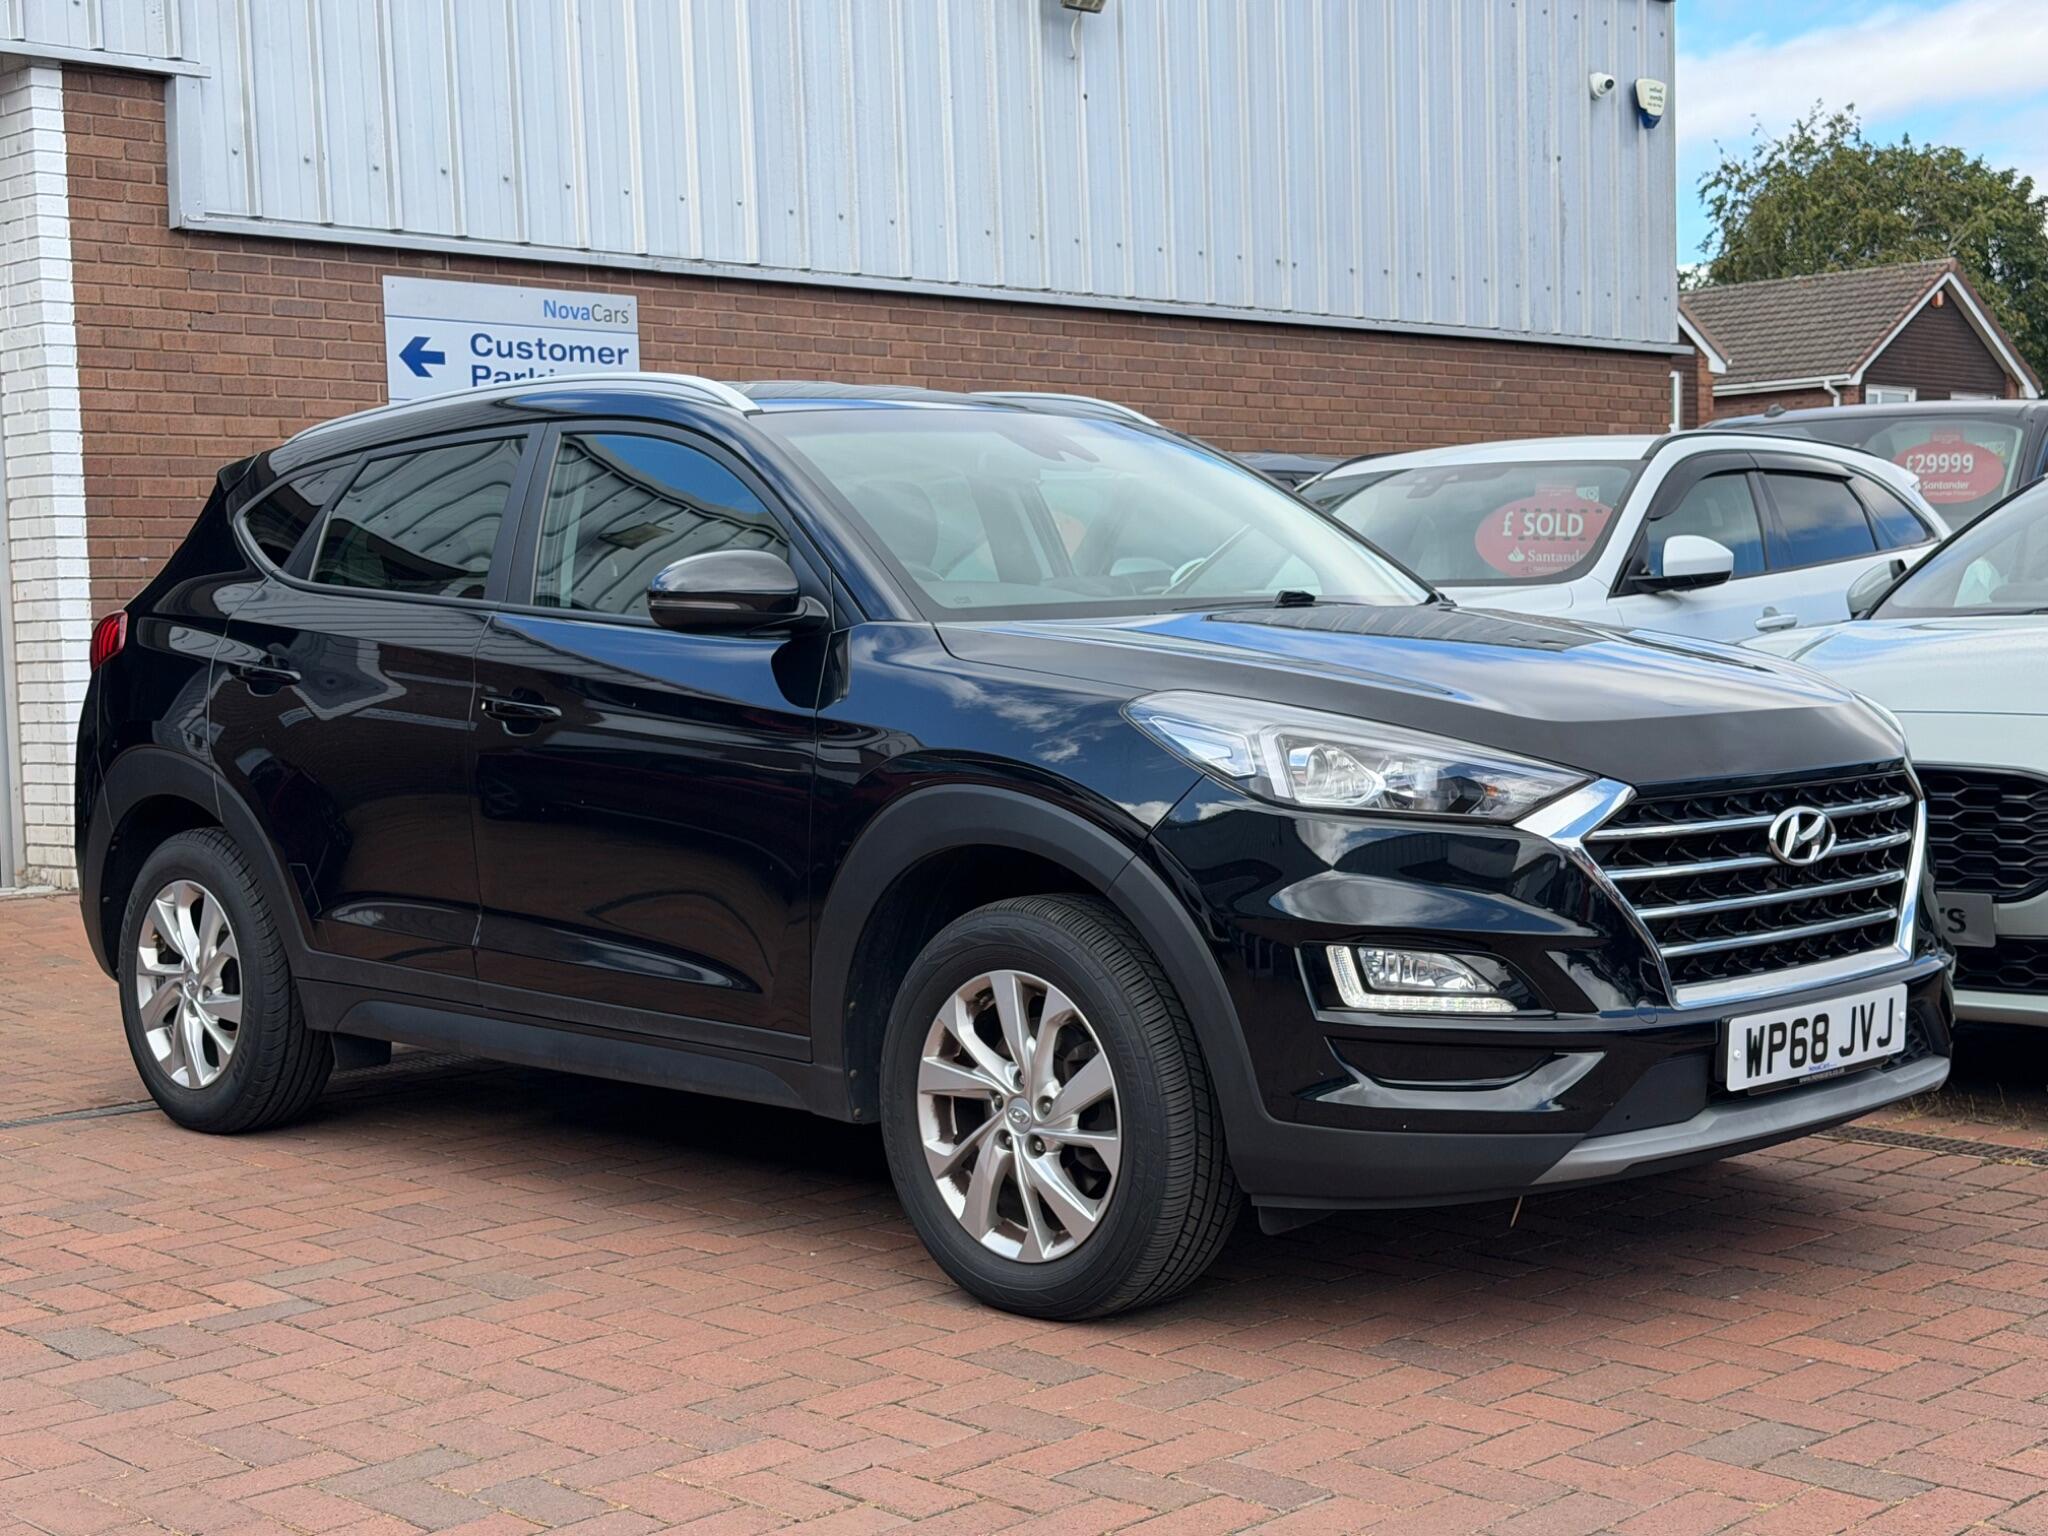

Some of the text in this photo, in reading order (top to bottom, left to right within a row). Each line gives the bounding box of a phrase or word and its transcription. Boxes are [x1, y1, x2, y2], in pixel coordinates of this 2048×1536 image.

[543, 299, 630, 325] NovaCars
[470, 332, 630, 366] Customer
[1906, 452, 1974, 474] £29999
[1922, 480, 1970, 490] Santander
[1502, 511, 1584, 538] £ SOLD
[1746, 997, 1894, 1079] WP68 JVJ
